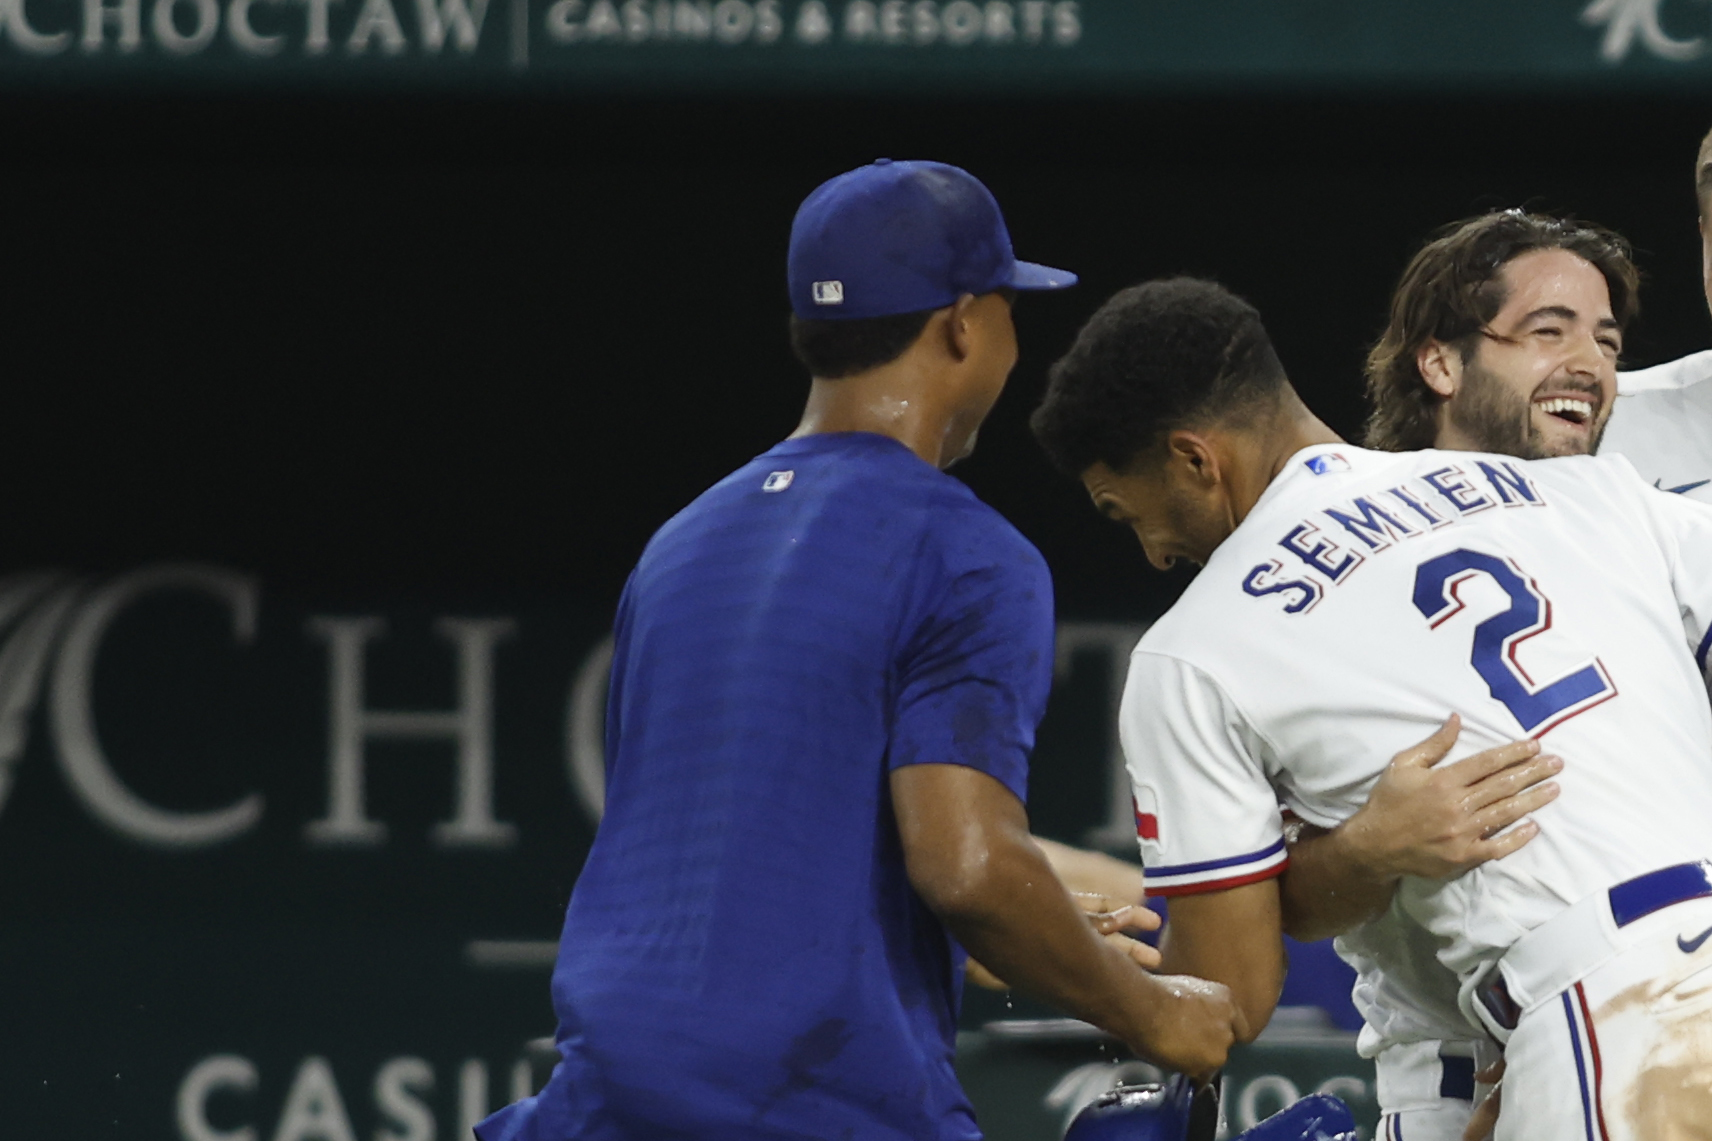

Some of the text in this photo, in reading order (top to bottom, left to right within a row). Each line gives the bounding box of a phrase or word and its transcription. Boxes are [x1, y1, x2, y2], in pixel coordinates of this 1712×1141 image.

[545, 0, 784, 46] CASINOS
[844, 0, 1083, 46] RESORTS
[1241, 459, 1546, 616] SEMIEN
[1412, 547, 1618, 739] 2
